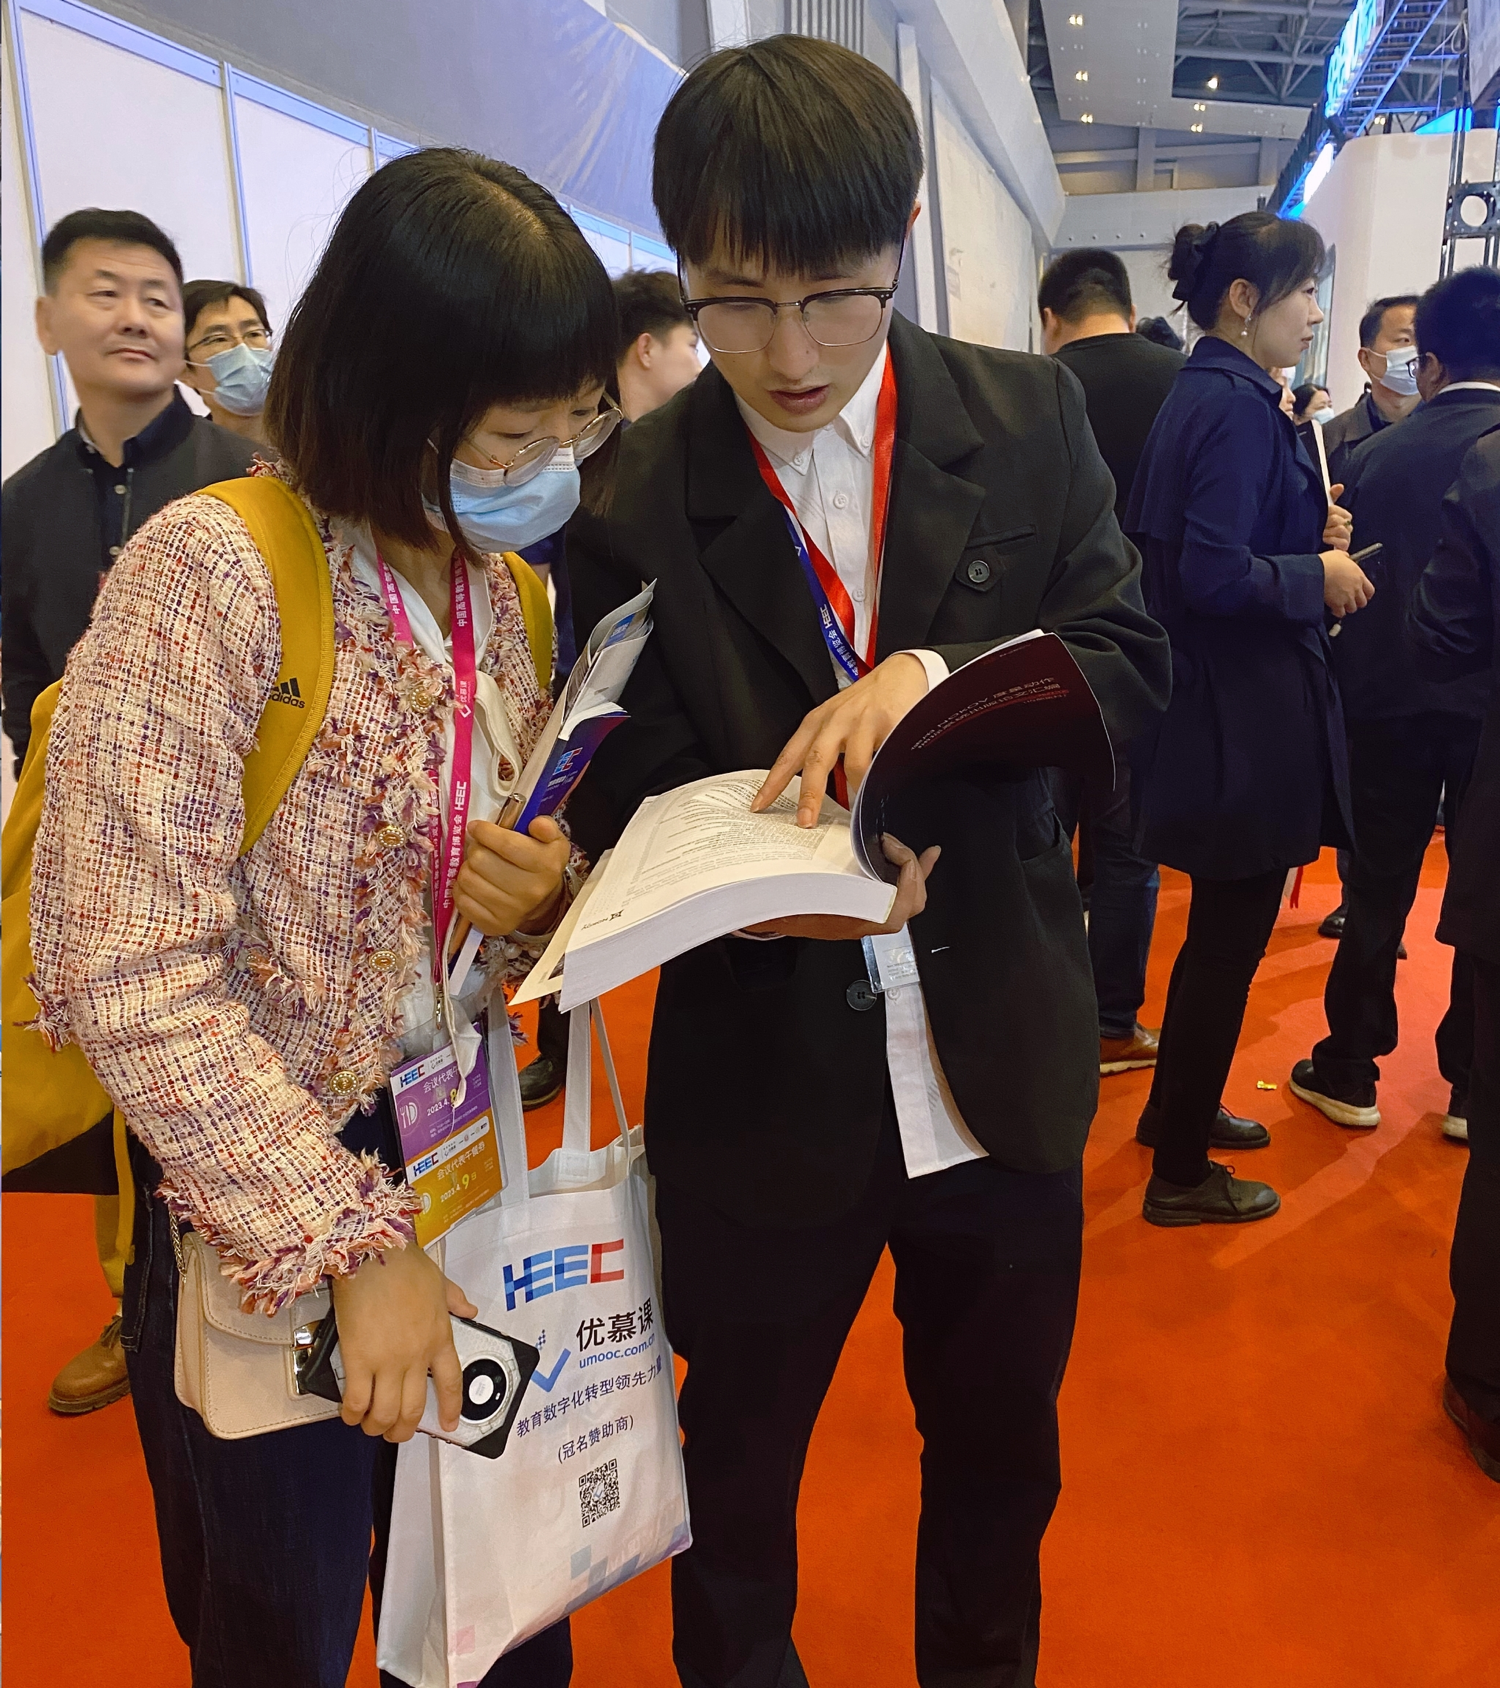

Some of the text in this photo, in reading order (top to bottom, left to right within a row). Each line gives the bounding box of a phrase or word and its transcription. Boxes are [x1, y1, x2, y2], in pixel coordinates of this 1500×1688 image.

[269, 690, 306, 709] didas
[937, 697, 989, 728] NOKOV
[454, 780, 467, 811] HEEC
[400, 1063, 426, 1089] HEEC
[413, 1152, 440, 1178] HEEC
[503, 1238, 625, 1312] HEEC
[576, 1297, 654, 1352] 优慕课
[516, 1354, 662, 1438] 教育数字化转型领先力量
[557, 1414, 635, 1464] (冠名赞助商)
